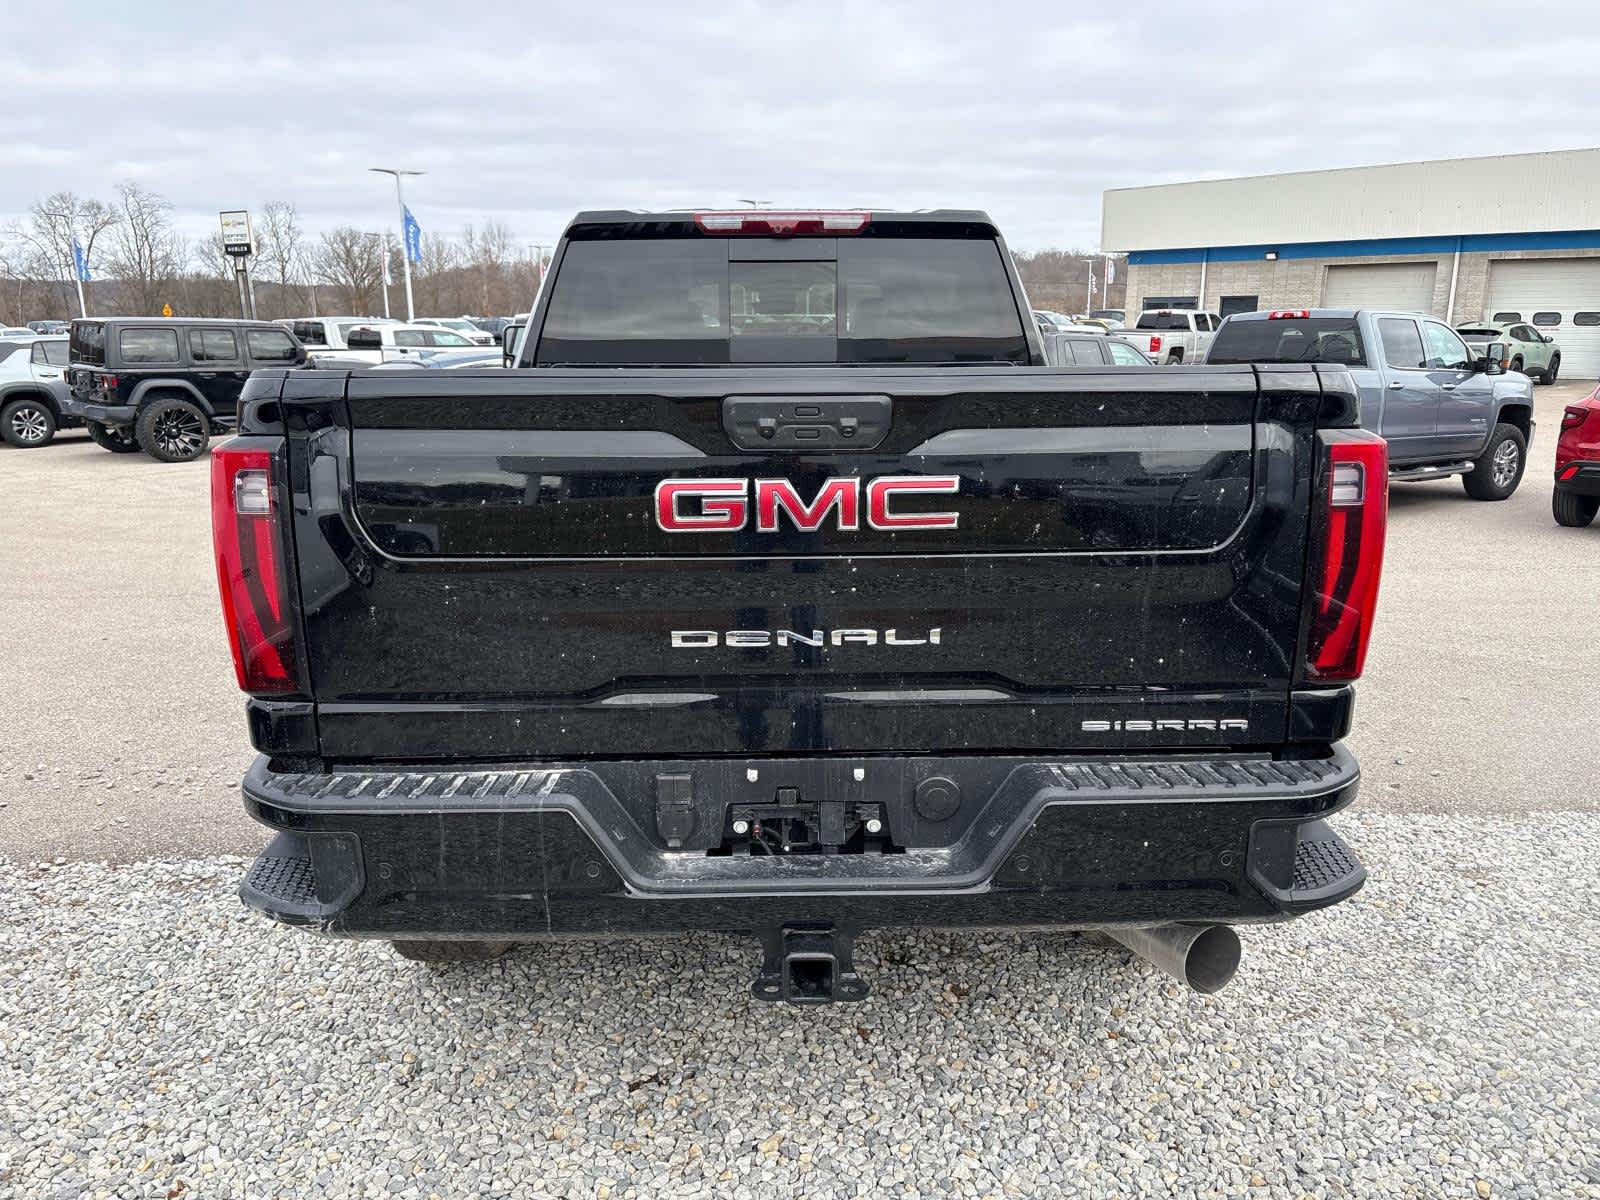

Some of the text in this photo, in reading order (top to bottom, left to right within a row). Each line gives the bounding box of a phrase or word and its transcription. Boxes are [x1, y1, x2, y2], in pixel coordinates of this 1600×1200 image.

[654, 474, 960, 533] GMC
[671, 627, 942, 648] DENALI
[1081, 719, 1249, 731] SIERRA
